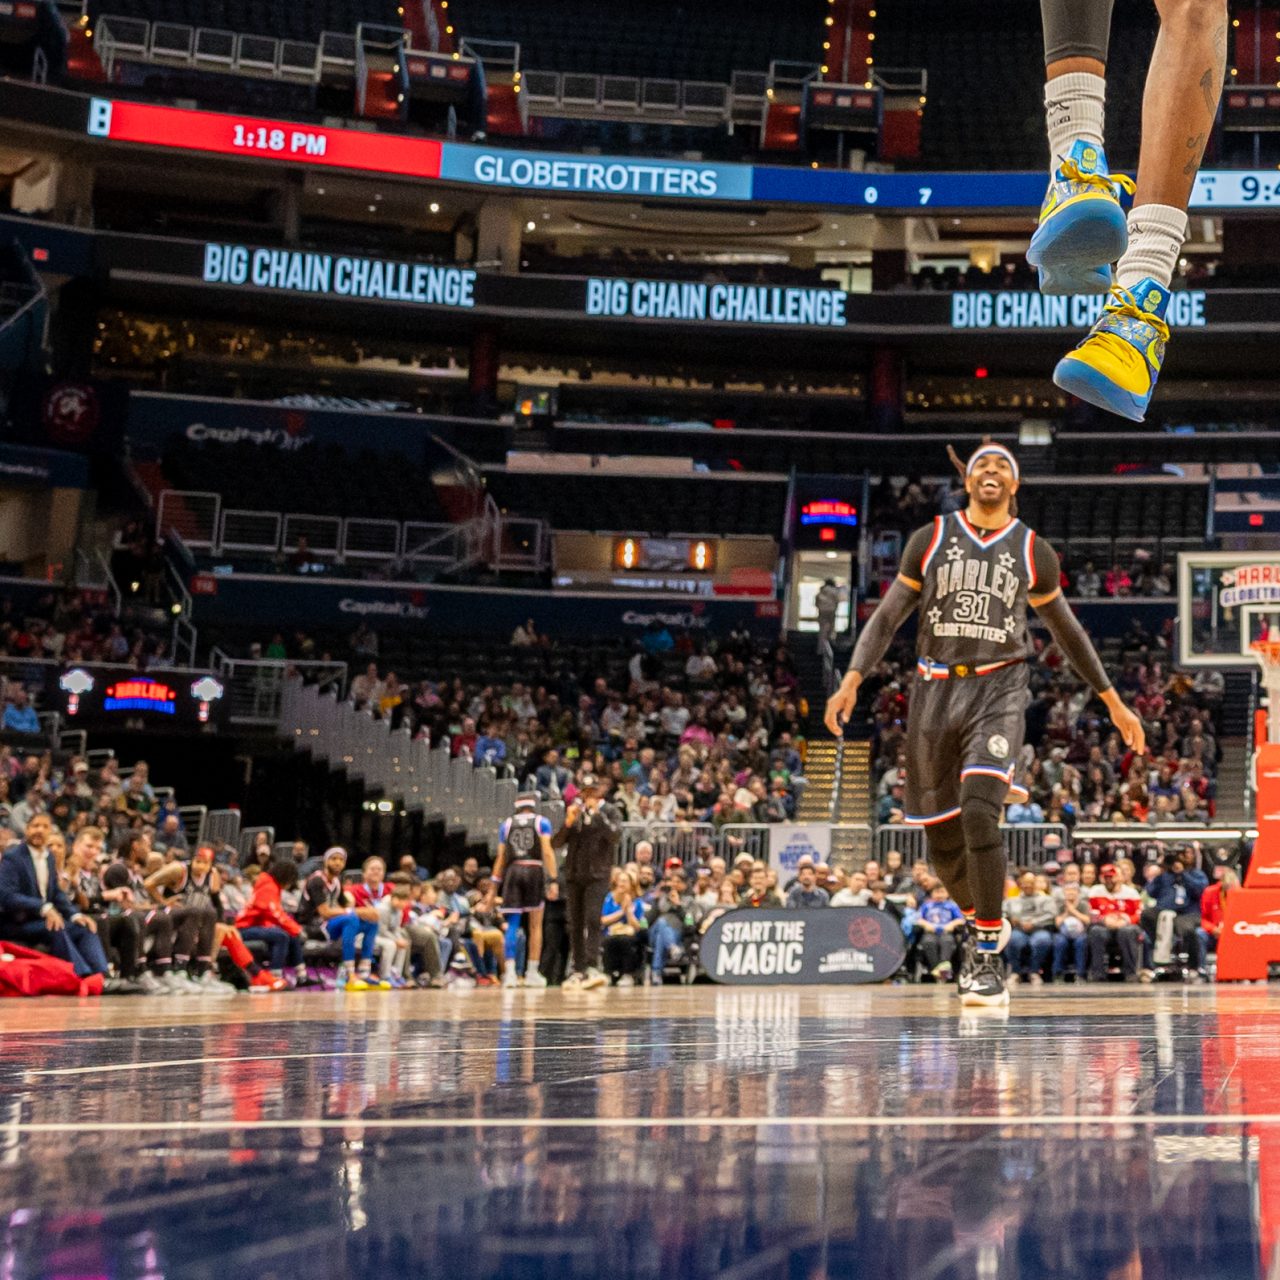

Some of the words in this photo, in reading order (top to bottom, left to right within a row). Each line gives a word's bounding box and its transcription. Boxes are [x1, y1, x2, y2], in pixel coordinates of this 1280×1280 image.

[233, 124, 285, 151] 1:18
[290, 131, 327, 157] PM
[473, 153, 718, 197] GLOBETROTTERS
[864, 186, 879, 204] 0
[918, 187, 933, 205] 7
[203, 243, 248, 285] BIG
[252, 248, 332, 293] CHAIN
[333, 258, 478, 308] CHALLENGE
[586, 278, 628, 315] BIG
[632, 281, 707, 320] CHAIN
[709, 284, 847, 327] CHALLENGE
[952, 291, 992, 328] BIG
[995, 291, 1069, 328] CHAIN
[935, 558, 1020, 610] HARLEM
[952, 589, 991, 625] 31
[933, 622, 1008, 644] GLOBETROTTERS
[720, 920, 771, 944] START
[774, 920, 806, 942] THE
[716, 942, 804, 976] MAGIC
